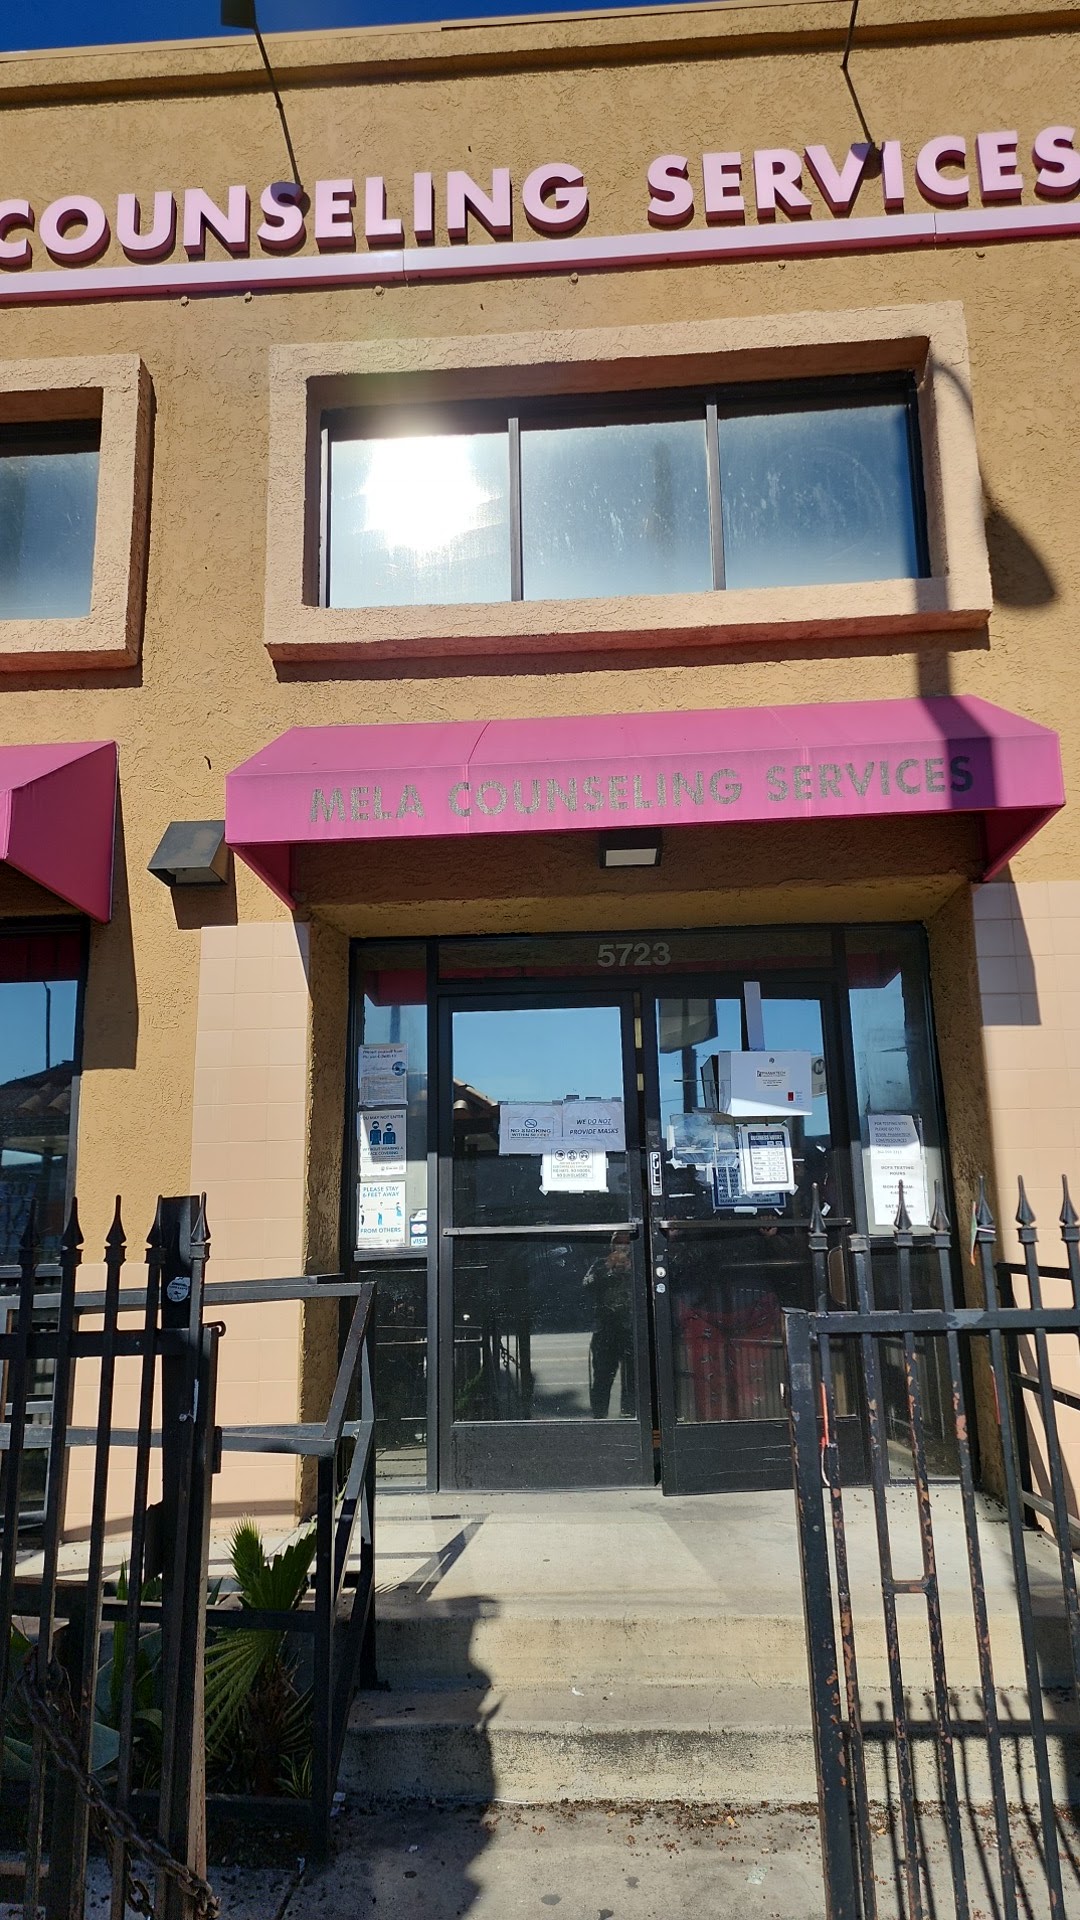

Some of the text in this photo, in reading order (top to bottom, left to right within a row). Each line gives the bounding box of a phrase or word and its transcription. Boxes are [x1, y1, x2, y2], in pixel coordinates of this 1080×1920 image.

[0, 126, 1080, 265] COUNSELING SERVICES
[308, 756, 973, 822] MELA COUNSELING SERVICES
[597, 942, 672, 968] 5723
[652, 1154, 660, 1184] PULL
